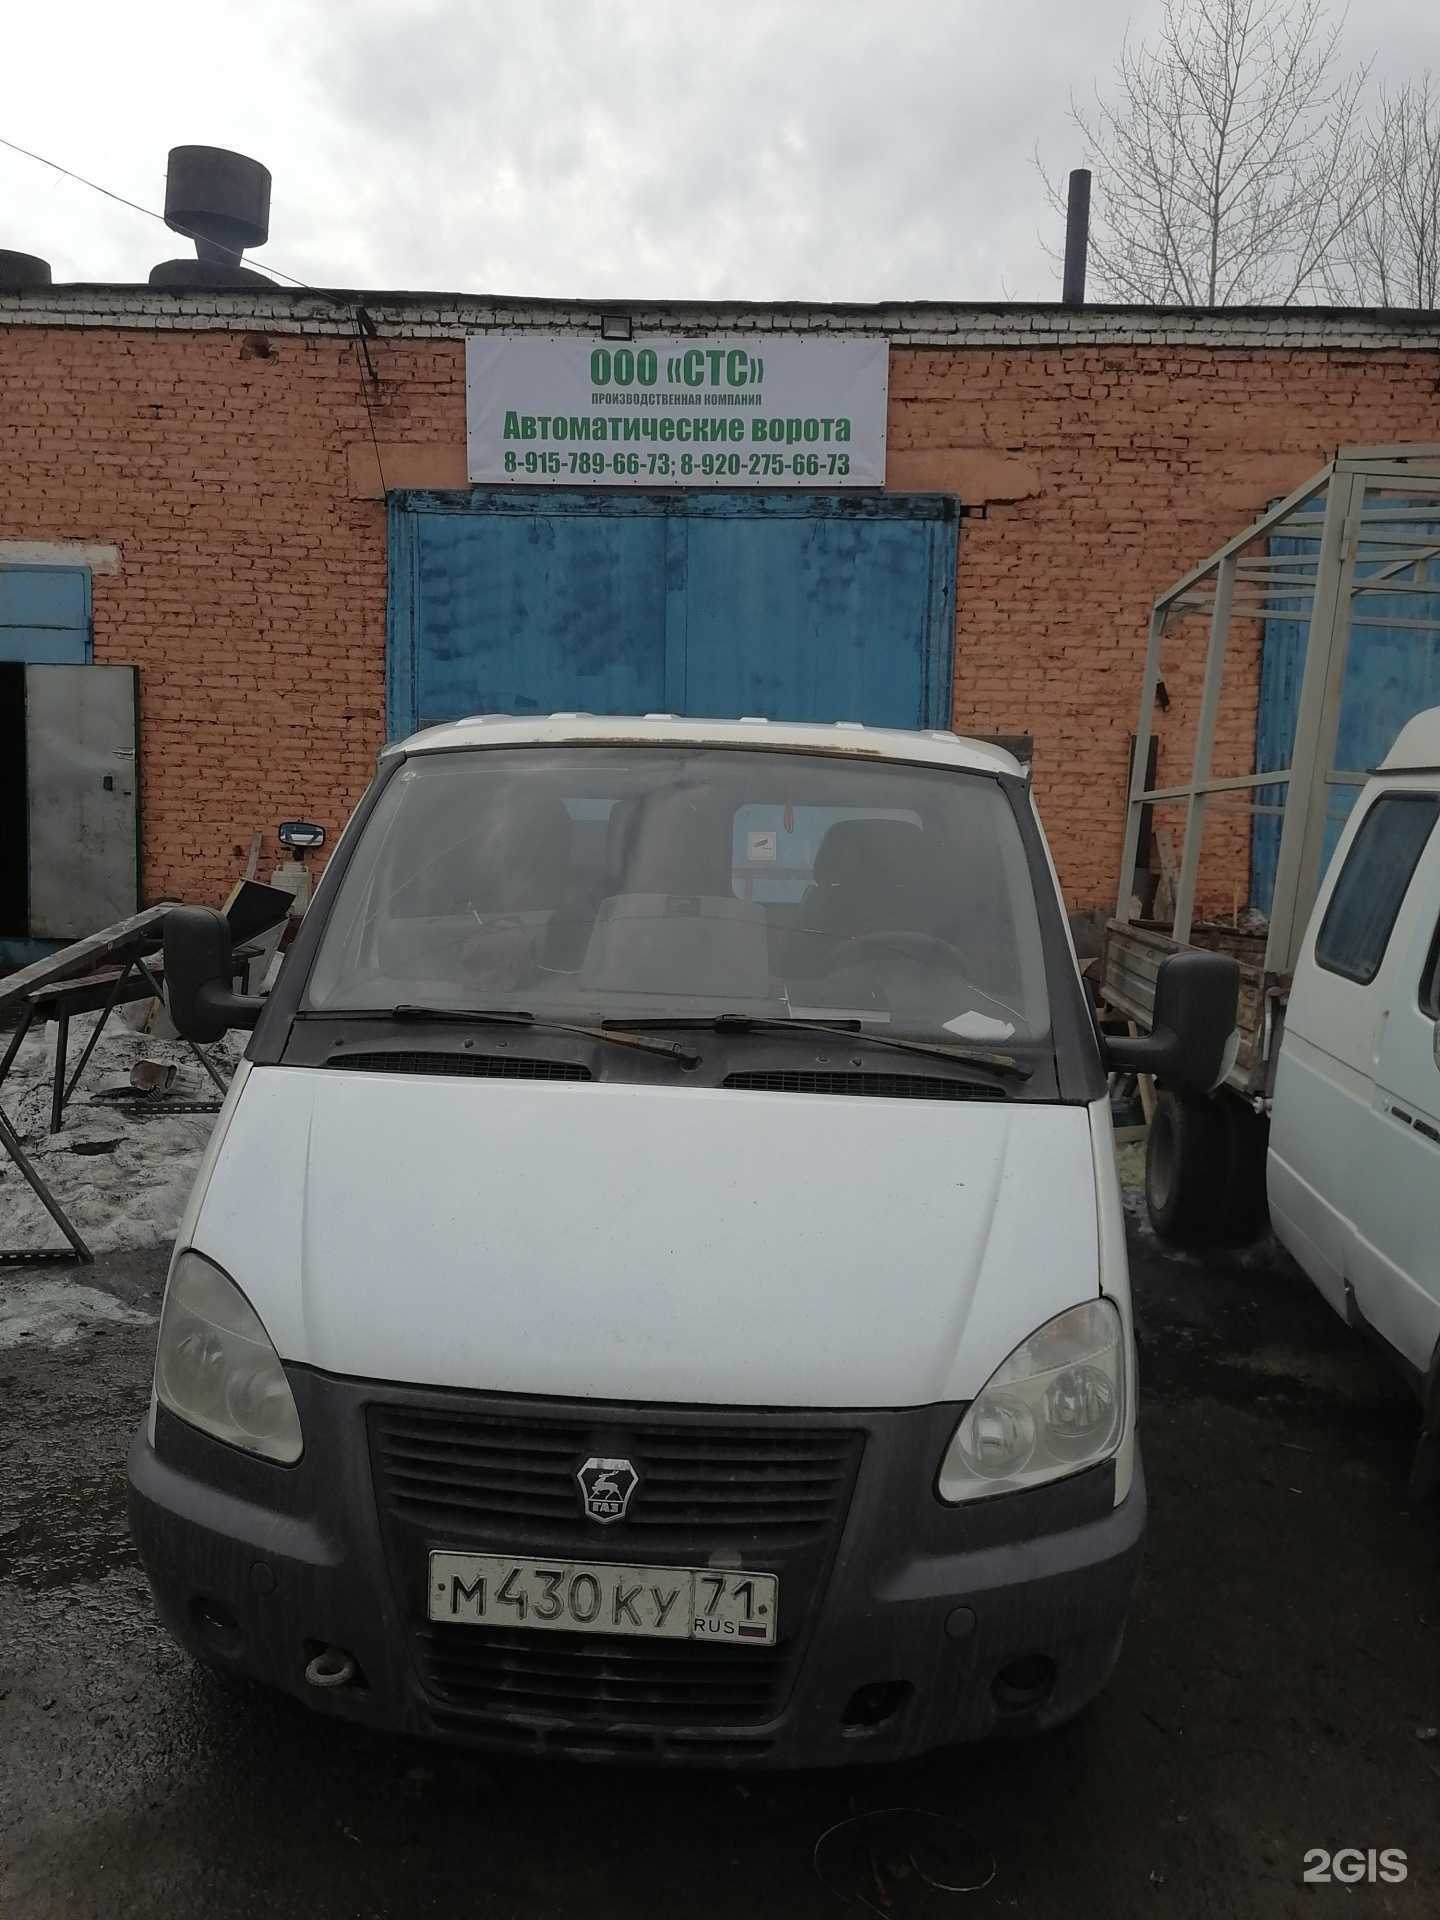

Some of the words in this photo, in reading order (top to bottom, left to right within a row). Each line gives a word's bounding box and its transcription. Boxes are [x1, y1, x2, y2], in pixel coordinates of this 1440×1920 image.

[591, 348, 657, 386] ООО
[667, 348, 764, 387] «СТС»
[591, 392, 701, 406] ПРОИЗВОДСТВЕННАЯ
[704, 393, 762, 406] КОМПАНИЯ
[503, 411, 744, 442] Автоматические
[751, 418, 851, 445] ворота
[504, 451, 676, 477] 8-915-789-66-73;
[680, 453, 850, 476] 8-920-275-66-73
[701, 1576, 755, 1621] 71
[694, 1618, 736, 1635] RUS
